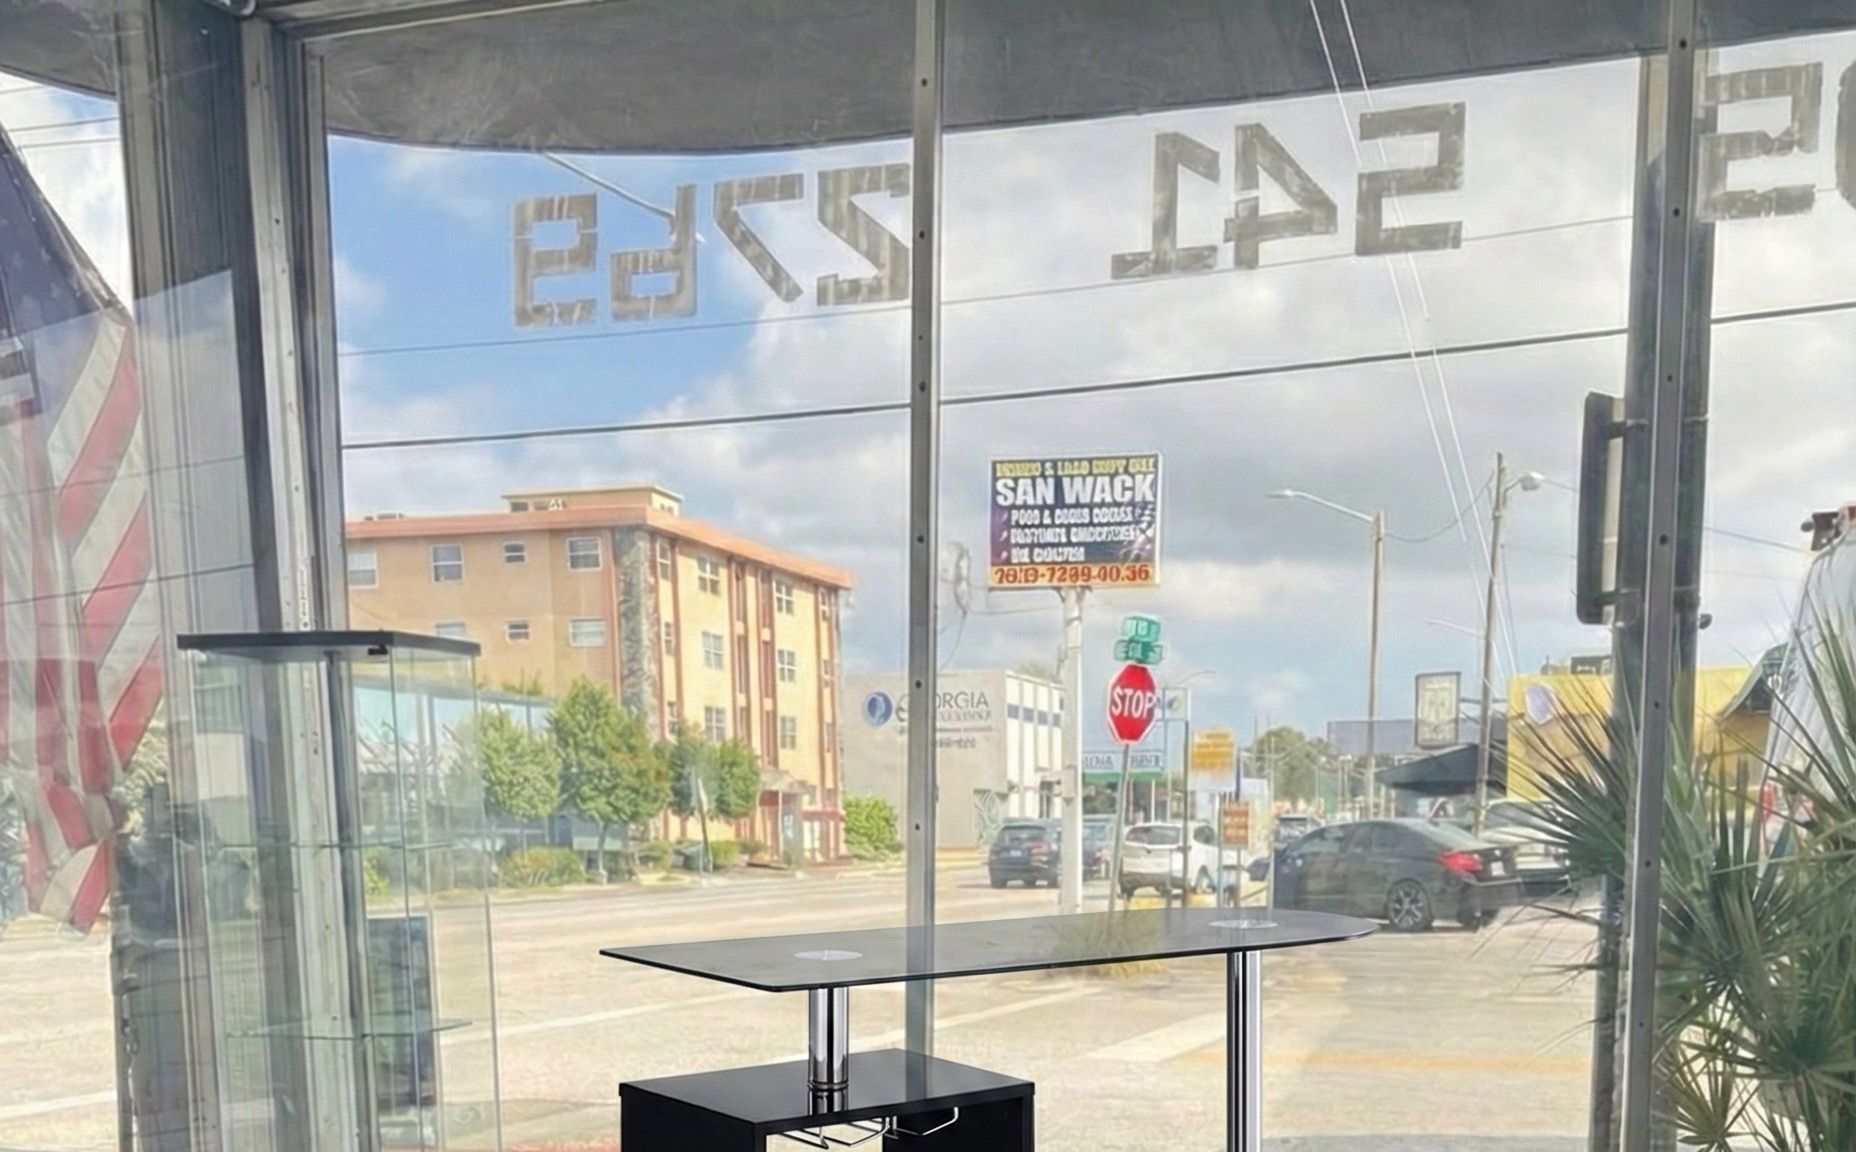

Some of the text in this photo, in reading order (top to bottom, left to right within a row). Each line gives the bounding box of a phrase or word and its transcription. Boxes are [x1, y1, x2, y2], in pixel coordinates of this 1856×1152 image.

[996, 474, 1155, 506] SAN WACK
[1112, 686, 1156, 719] STOP
